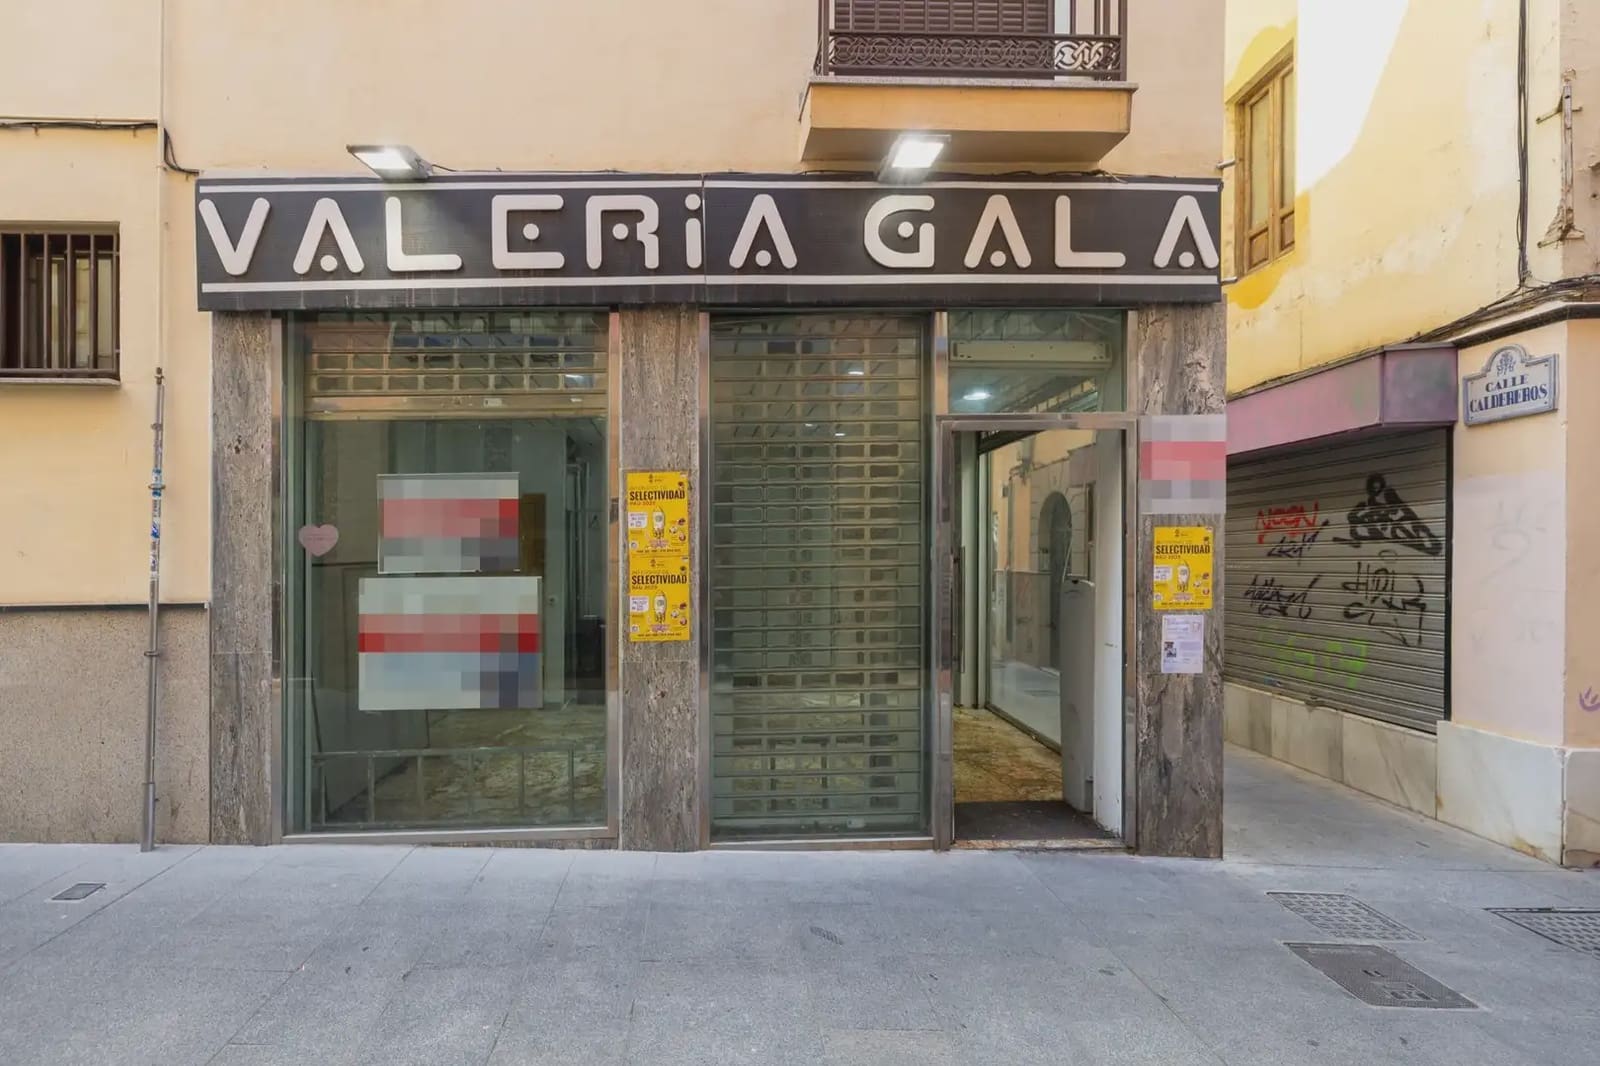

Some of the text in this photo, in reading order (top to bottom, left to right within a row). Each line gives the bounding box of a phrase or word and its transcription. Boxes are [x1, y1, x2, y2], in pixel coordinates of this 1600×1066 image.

[864, 193, 1220, 270] GALA
[1485, 373, 1529, 393] CALLE
[1469, 383, 1549, 413] CALDEREROS
[629, 489, 686, 501] SELECTIVIDAD
[1155, 544, 1211, 555] SELECTIVIDAD
[631, 574, 688, 585] SELECTIVIDAD
